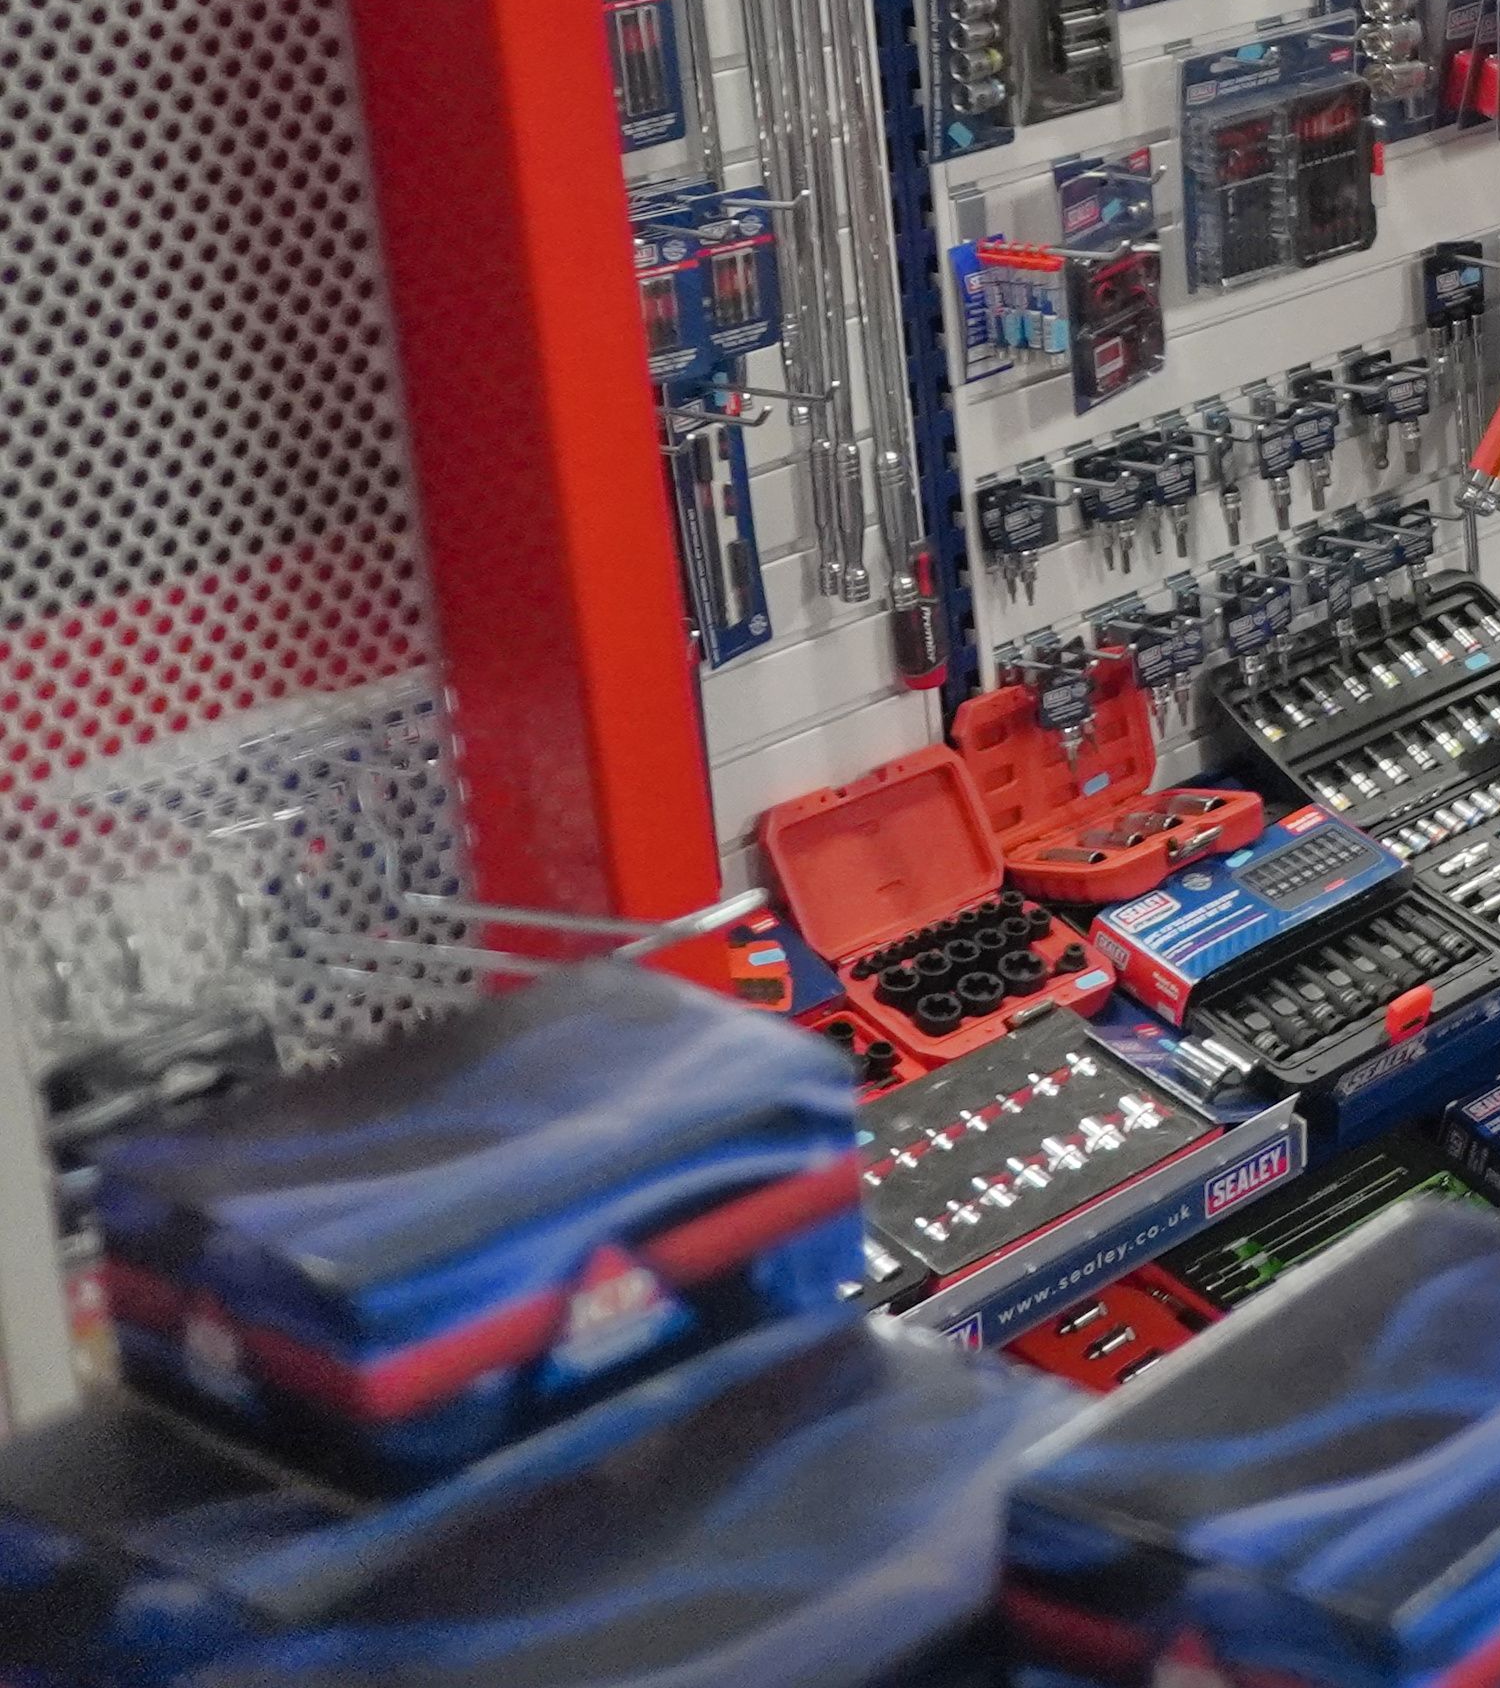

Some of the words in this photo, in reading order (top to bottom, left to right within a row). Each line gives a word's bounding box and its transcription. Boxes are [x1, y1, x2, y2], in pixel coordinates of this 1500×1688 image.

[1117, 893, 1169, 925] SEALEY
[997, 1205, 1195, 1326] www.sealey.co.uk
[1210, 1144, 1286, 1213] SEALEY
